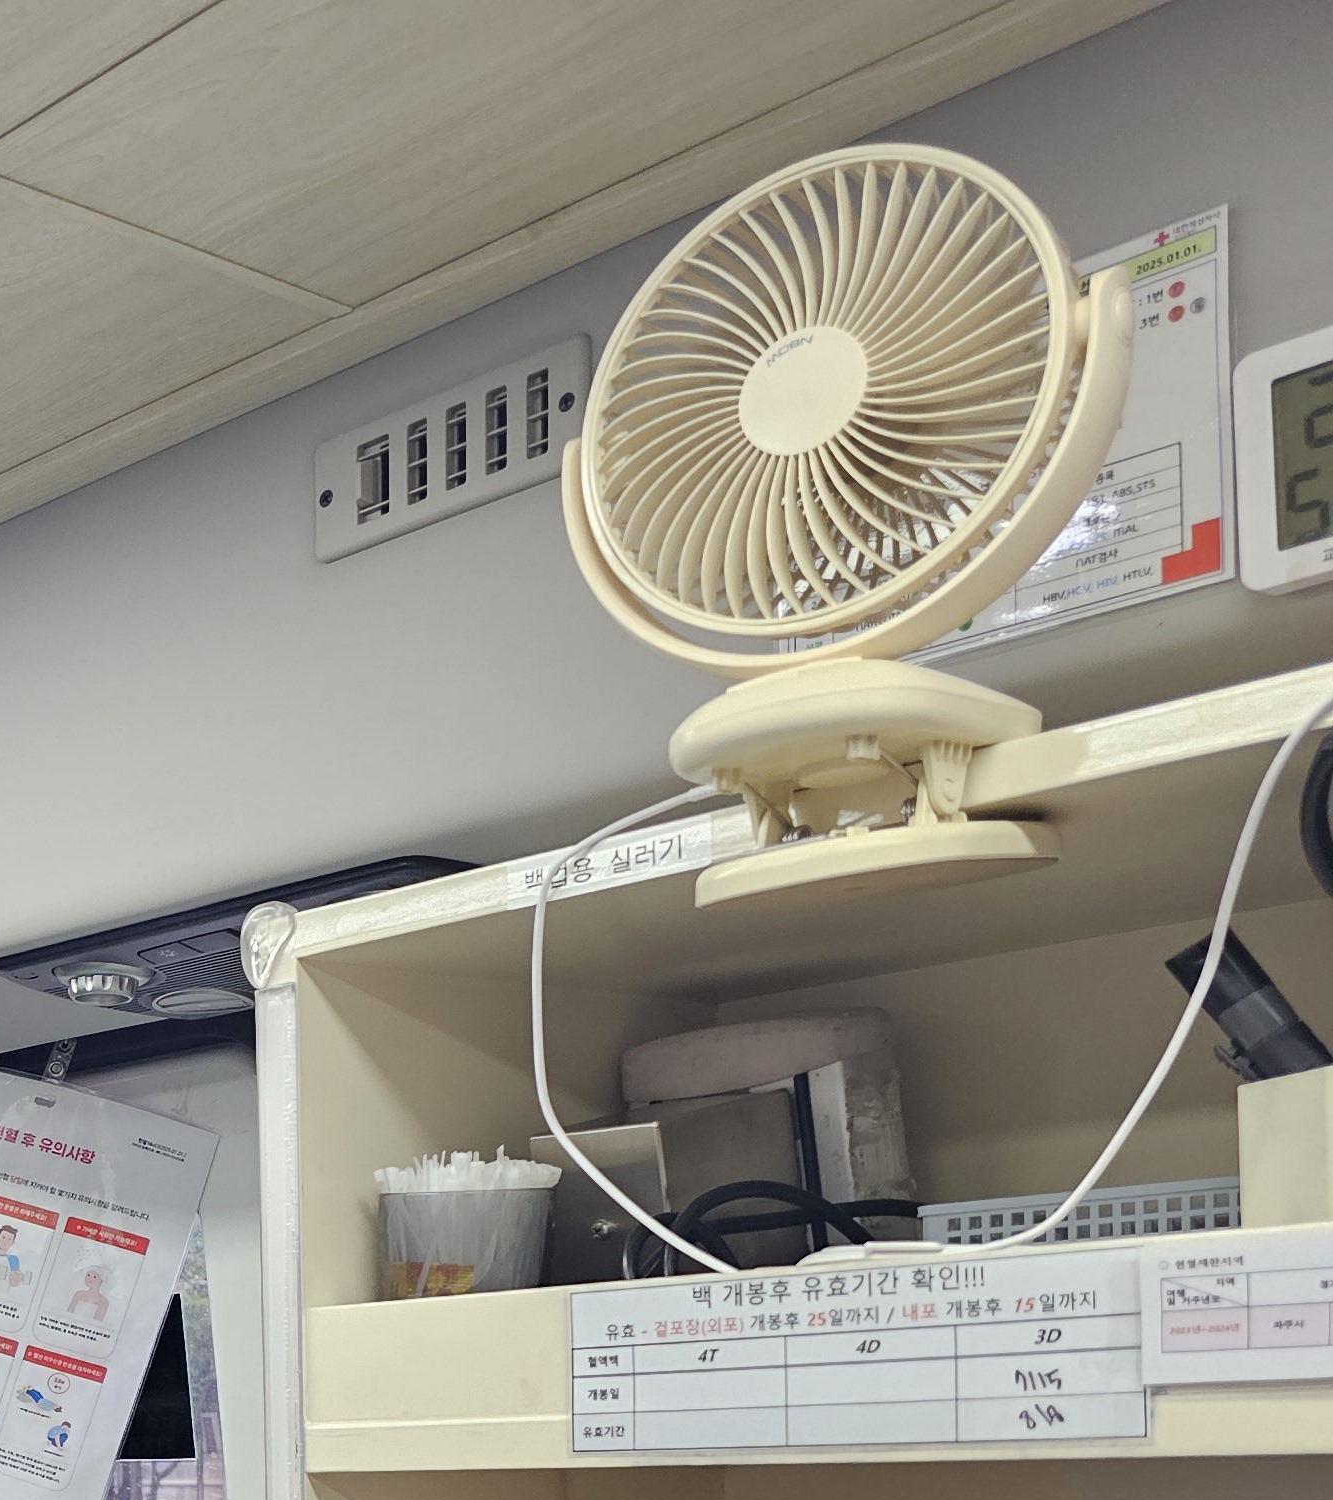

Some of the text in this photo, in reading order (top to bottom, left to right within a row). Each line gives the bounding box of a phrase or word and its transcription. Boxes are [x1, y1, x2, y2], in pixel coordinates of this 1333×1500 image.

[1136, 244, 1201, 275] 2025.01.01.
[611, 834, 682, 875] 실러기
[21, 1133, 36, 1148] 후
[38, 1137, 97, 1165] 유의사항
[692, 1264, 986, 1308] 백 개봉후 유효기간 확인!!!
[605, 1323, 635, 1340] 유효
[654, 1316, 744, 1338] 겉포장(외포)
[750, 1312, 800, 1330] 개봉후
[902, 1303, 938, 1322] 내포
[945, 1297, 1002, 1319] 개봉후
[1273, 1320, 1305, 1330] 파주시
[698, 1348, 719, 1363] 4T
[855, 1340, 881, 1354] 4D
[1034, 1328, 1062, 1344] 3D
[587, 1388, 620, 1400] 개봉일
[583, 1425, 625, 1438] 유효기간
